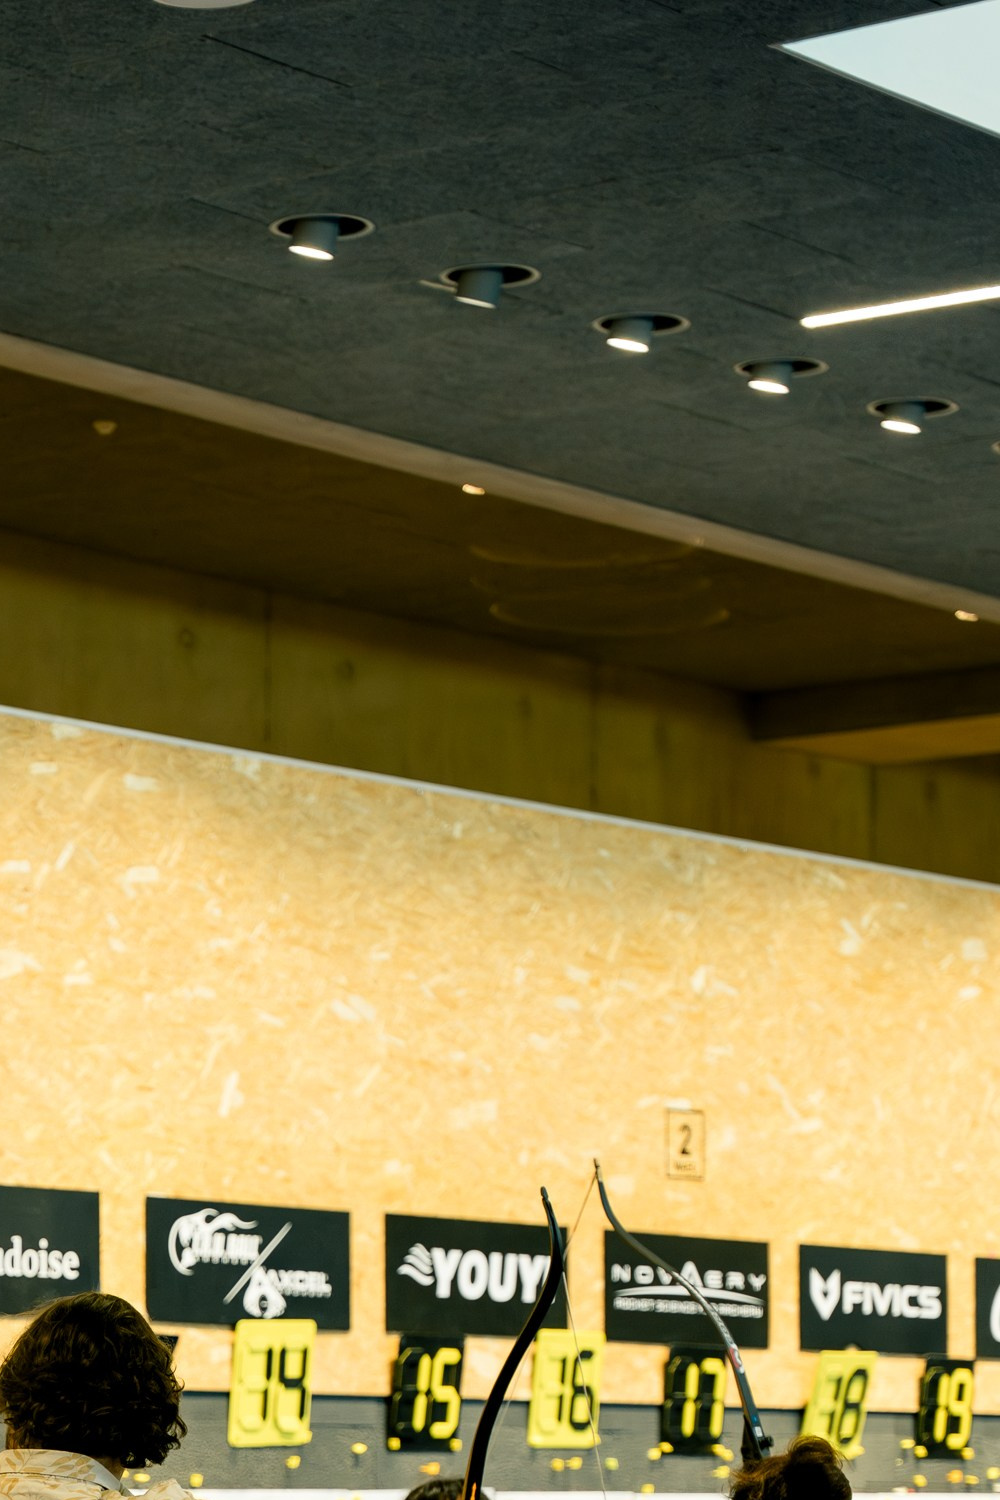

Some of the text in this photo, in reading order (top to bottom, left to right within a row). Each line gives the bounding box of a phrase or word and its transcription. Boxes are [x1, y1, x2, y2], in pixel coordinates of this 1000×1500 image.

[679, 1124, 692, 1155] 2
[430, 1246, 556, 1304] YOUY
[842, 1280, 942, 1319] FIVICS
[255, 1346, 308, 1423] 14
[412, 1347, 462, 1439] 15
[555, 1349, 594, 1432] 16
[680, 1357, 726, 1438] 17
[828, 1369, 870, 1444] 18
[934, 1366, 973, 1446] 19
